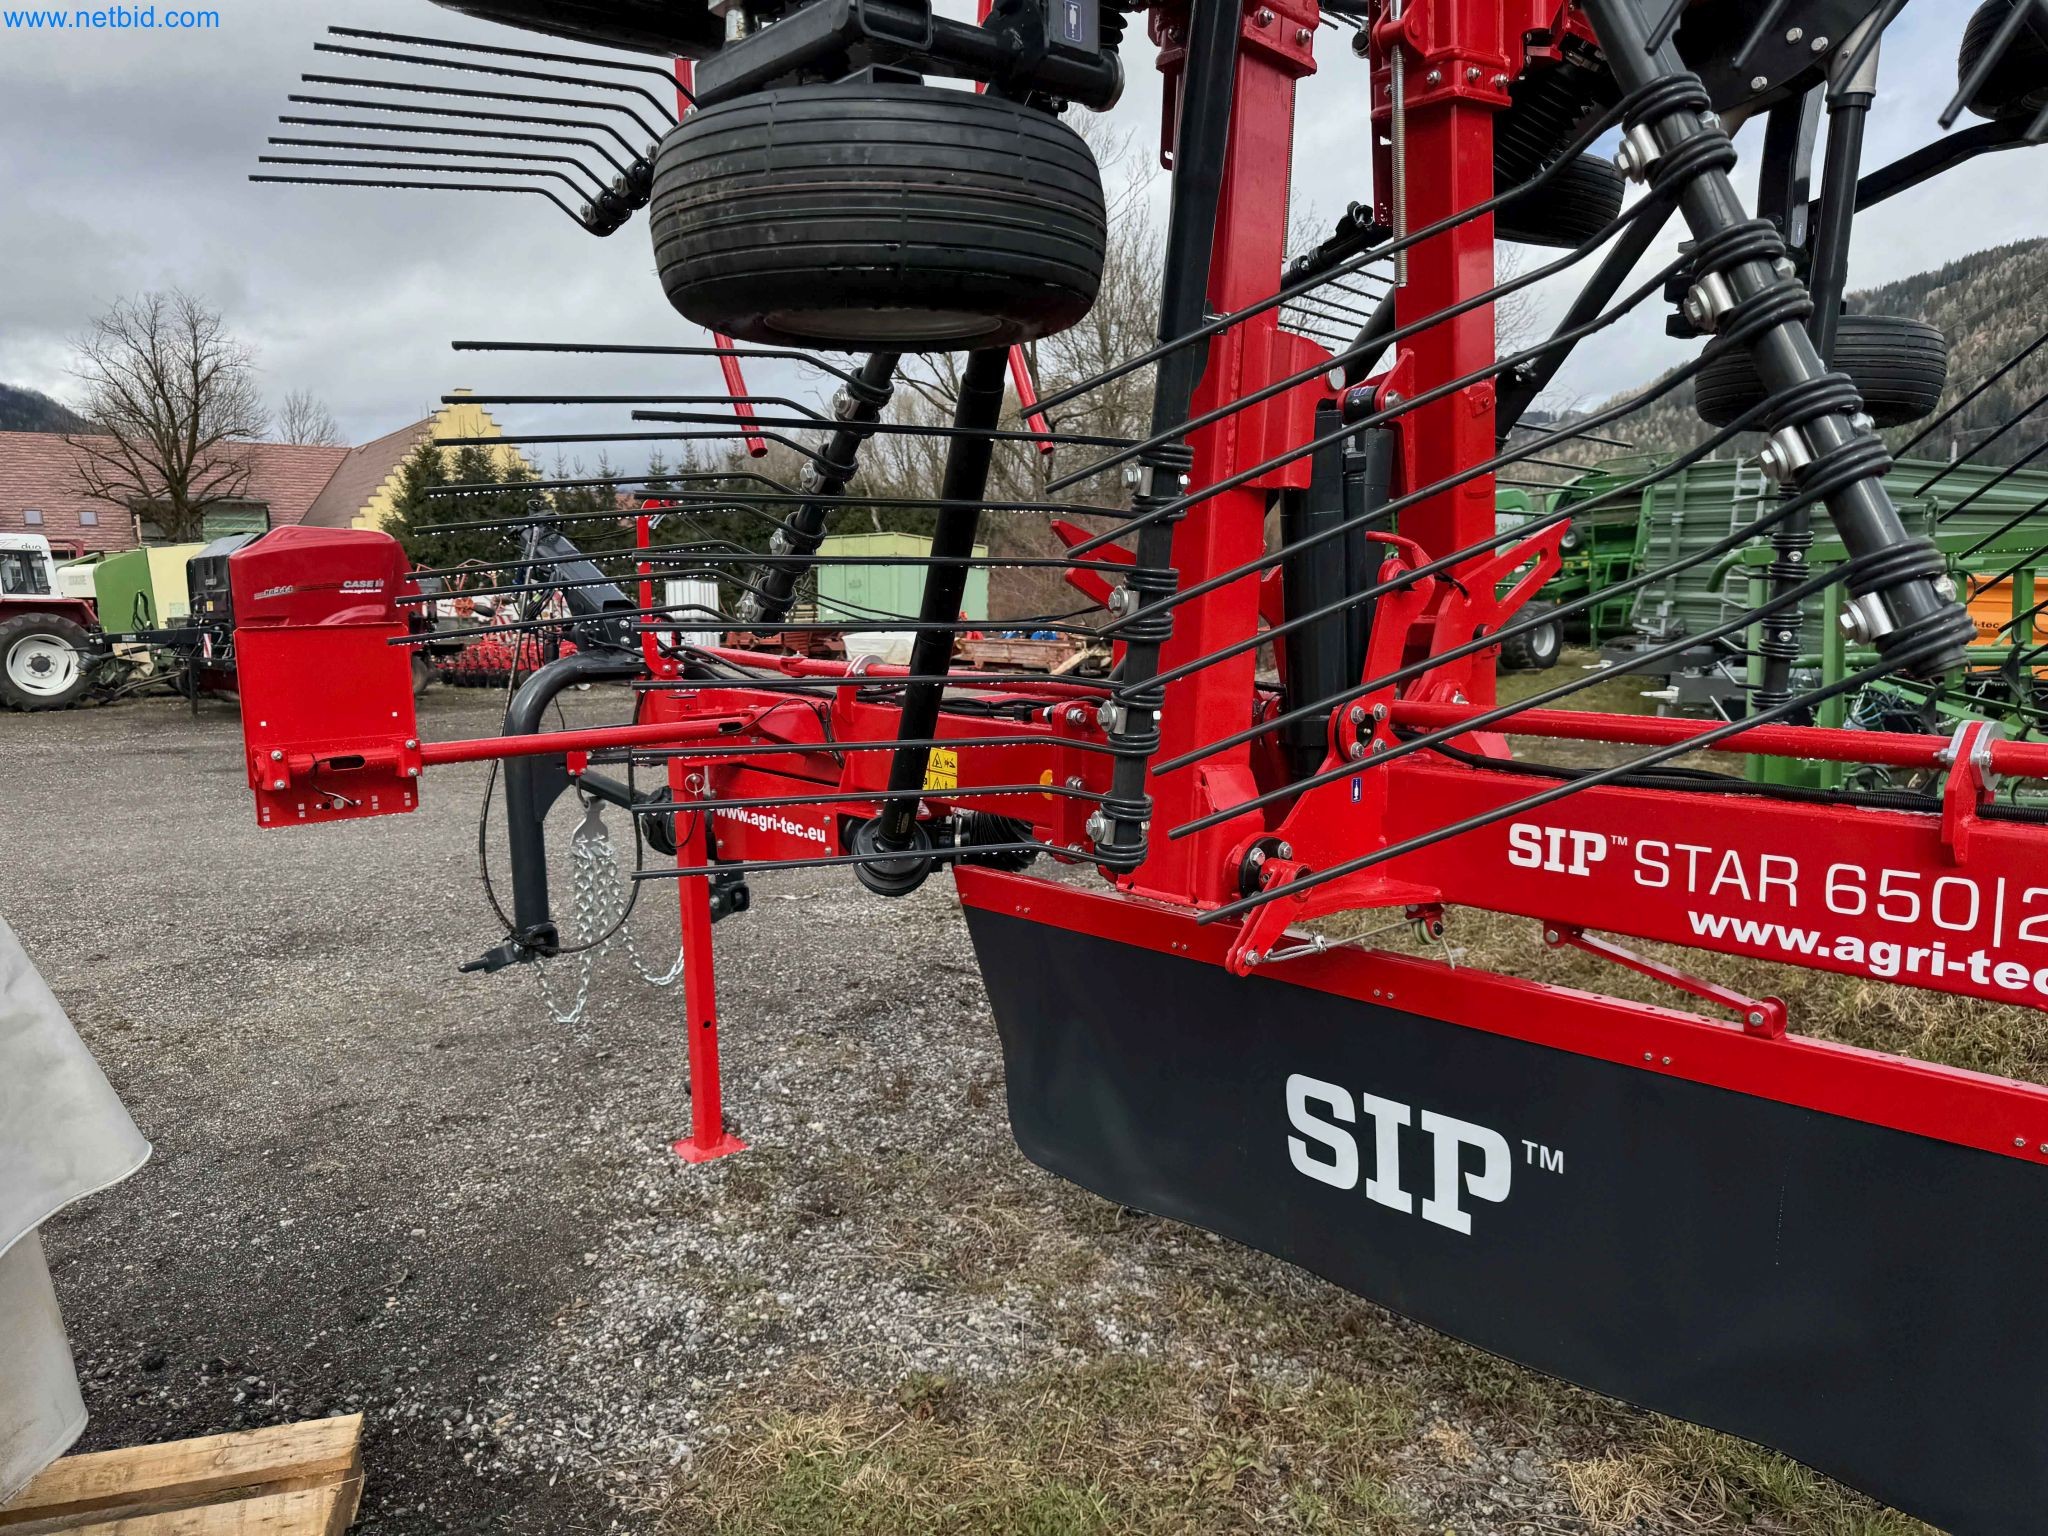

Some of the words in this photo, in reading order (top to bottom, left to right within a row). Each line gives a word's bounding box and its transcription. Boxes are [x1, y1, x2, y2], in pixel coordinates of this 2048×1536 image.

[343, 580, 375, 588] CASE
[716, 807, 826, 843] www.agri-tec.eu
[1634, 839, 1800, 908] STAR
